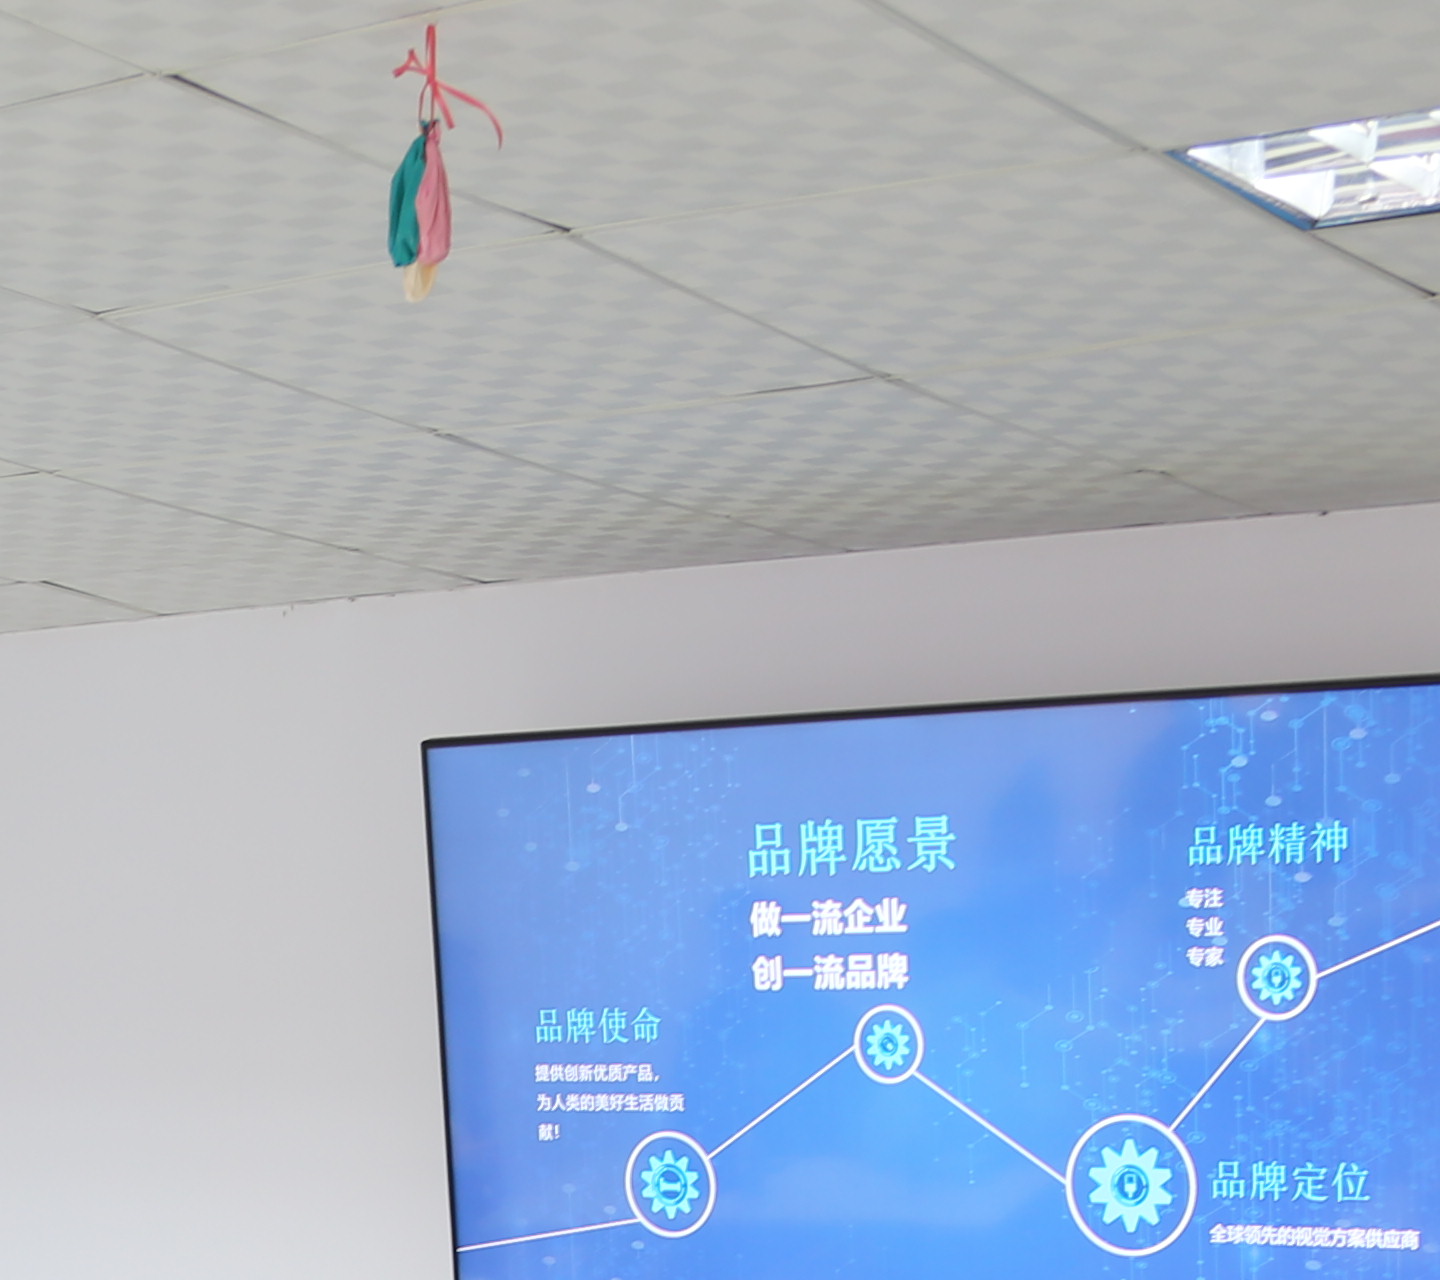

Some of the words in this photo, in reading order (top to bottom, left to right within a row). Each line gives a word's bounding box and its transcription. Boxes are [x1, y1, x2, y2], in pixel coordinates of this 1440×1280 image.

[748, 814, 958, 878] 品牌愿景
[1188, 819, 1349, 867] 品牌精神
[1184, 887, 1225, 909] 专注
[750, 897, 909, 938] 做一流企业
[1185, 916, 1225, 938] 专业
[751, 952, 910, 991] 创一流品牌
[1185, 946, 1225, 967] 专家
[535, 1007, 662, 1044] 品牌使命
[1211, 1160, 1371, 1203] 品牌定位
[1209, 1223, 1421, 1250] 全球领先的视觉方案供应商
